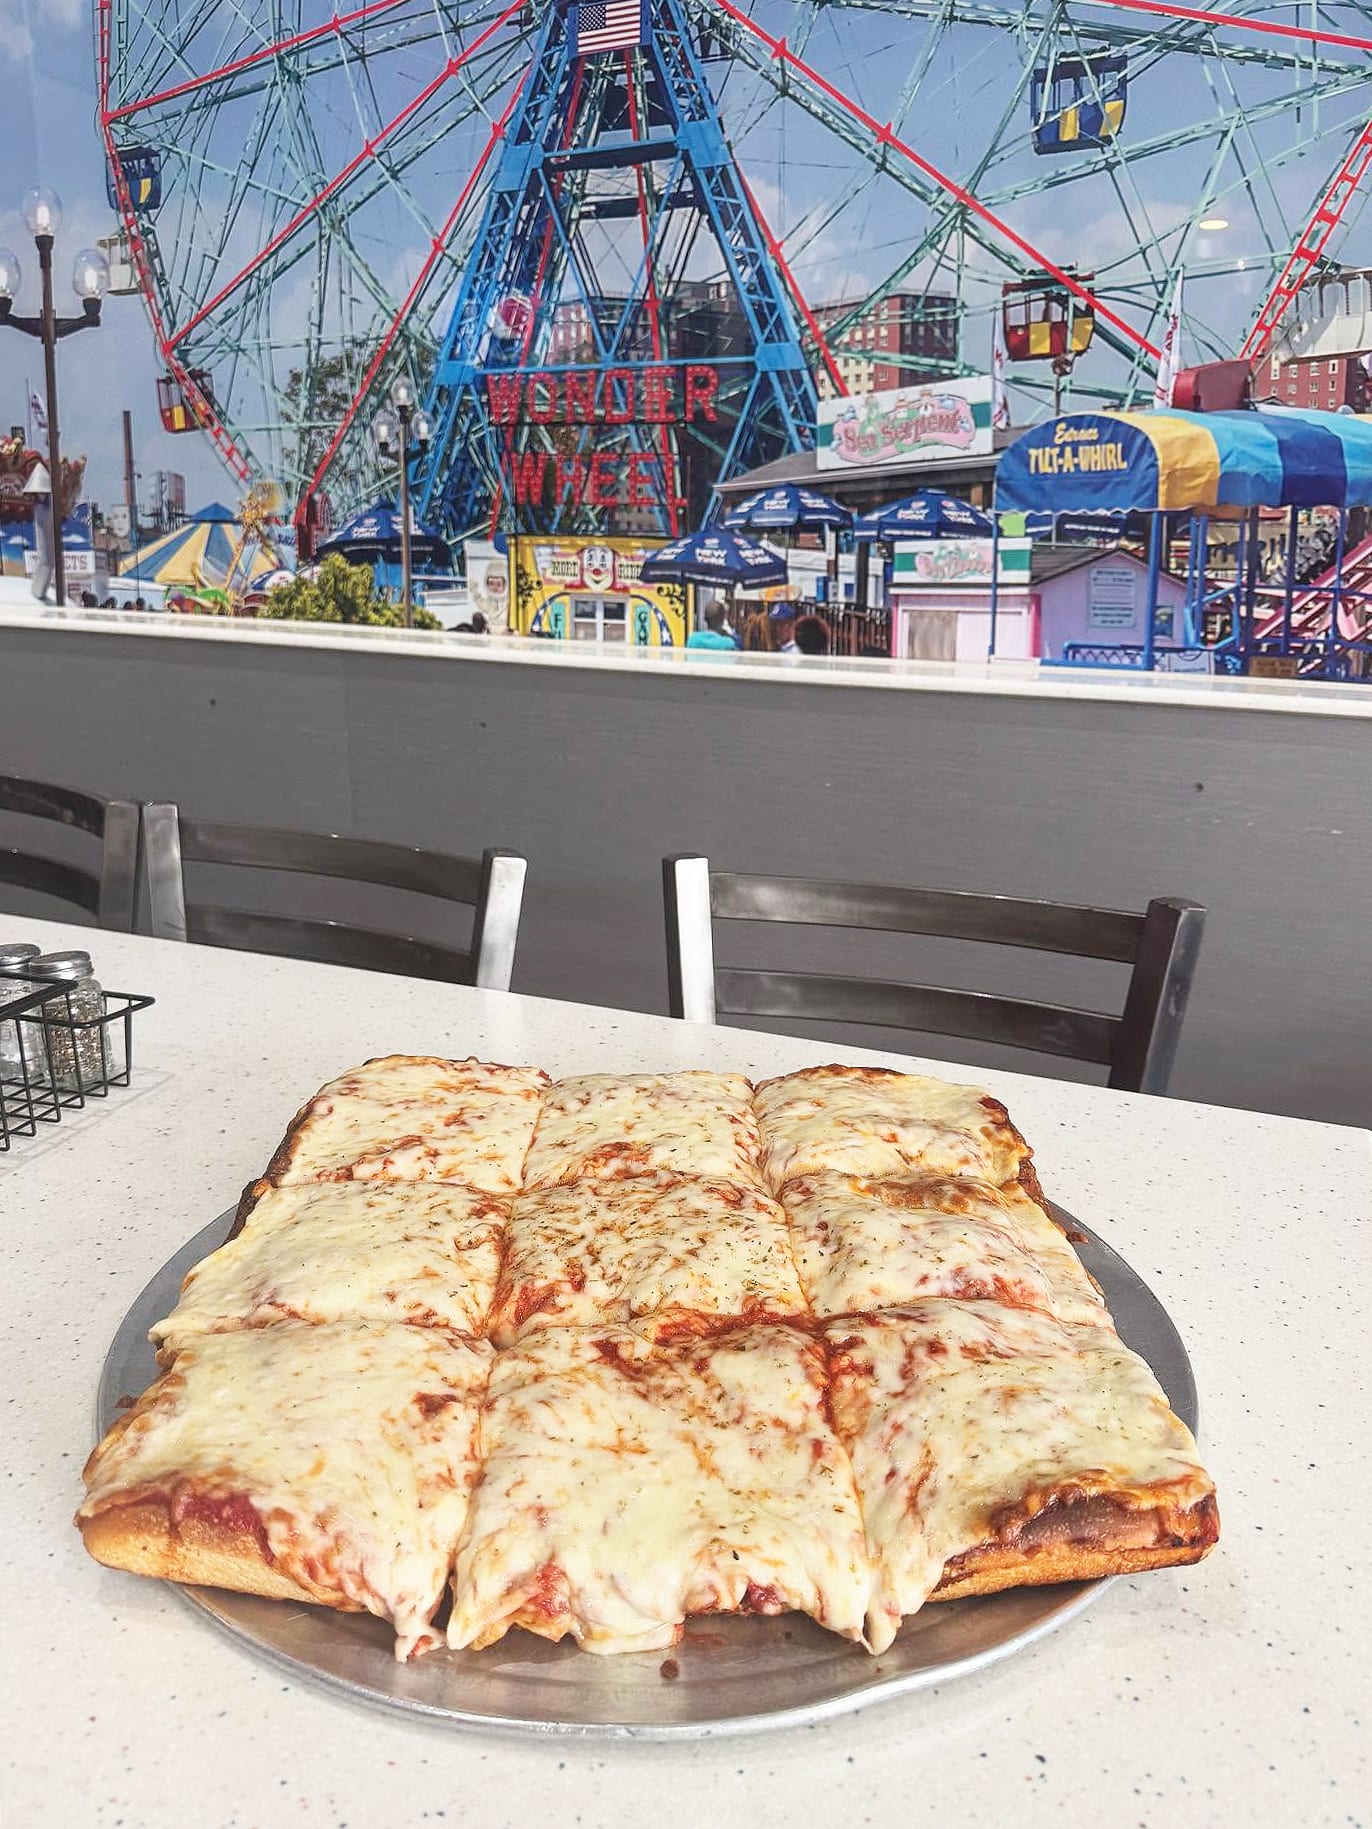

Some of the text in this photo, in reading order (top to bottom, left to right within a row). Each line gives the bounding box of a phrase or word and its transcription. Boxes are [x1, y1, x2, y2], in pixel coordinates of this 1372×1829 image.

[486, 365, 719, 425] WONDER
[843, 427, 877, 452] Sea
[1028, 442, 1128, 475] TILT-A-WHIRL
[511, 450, 688, 507] WHEEL
